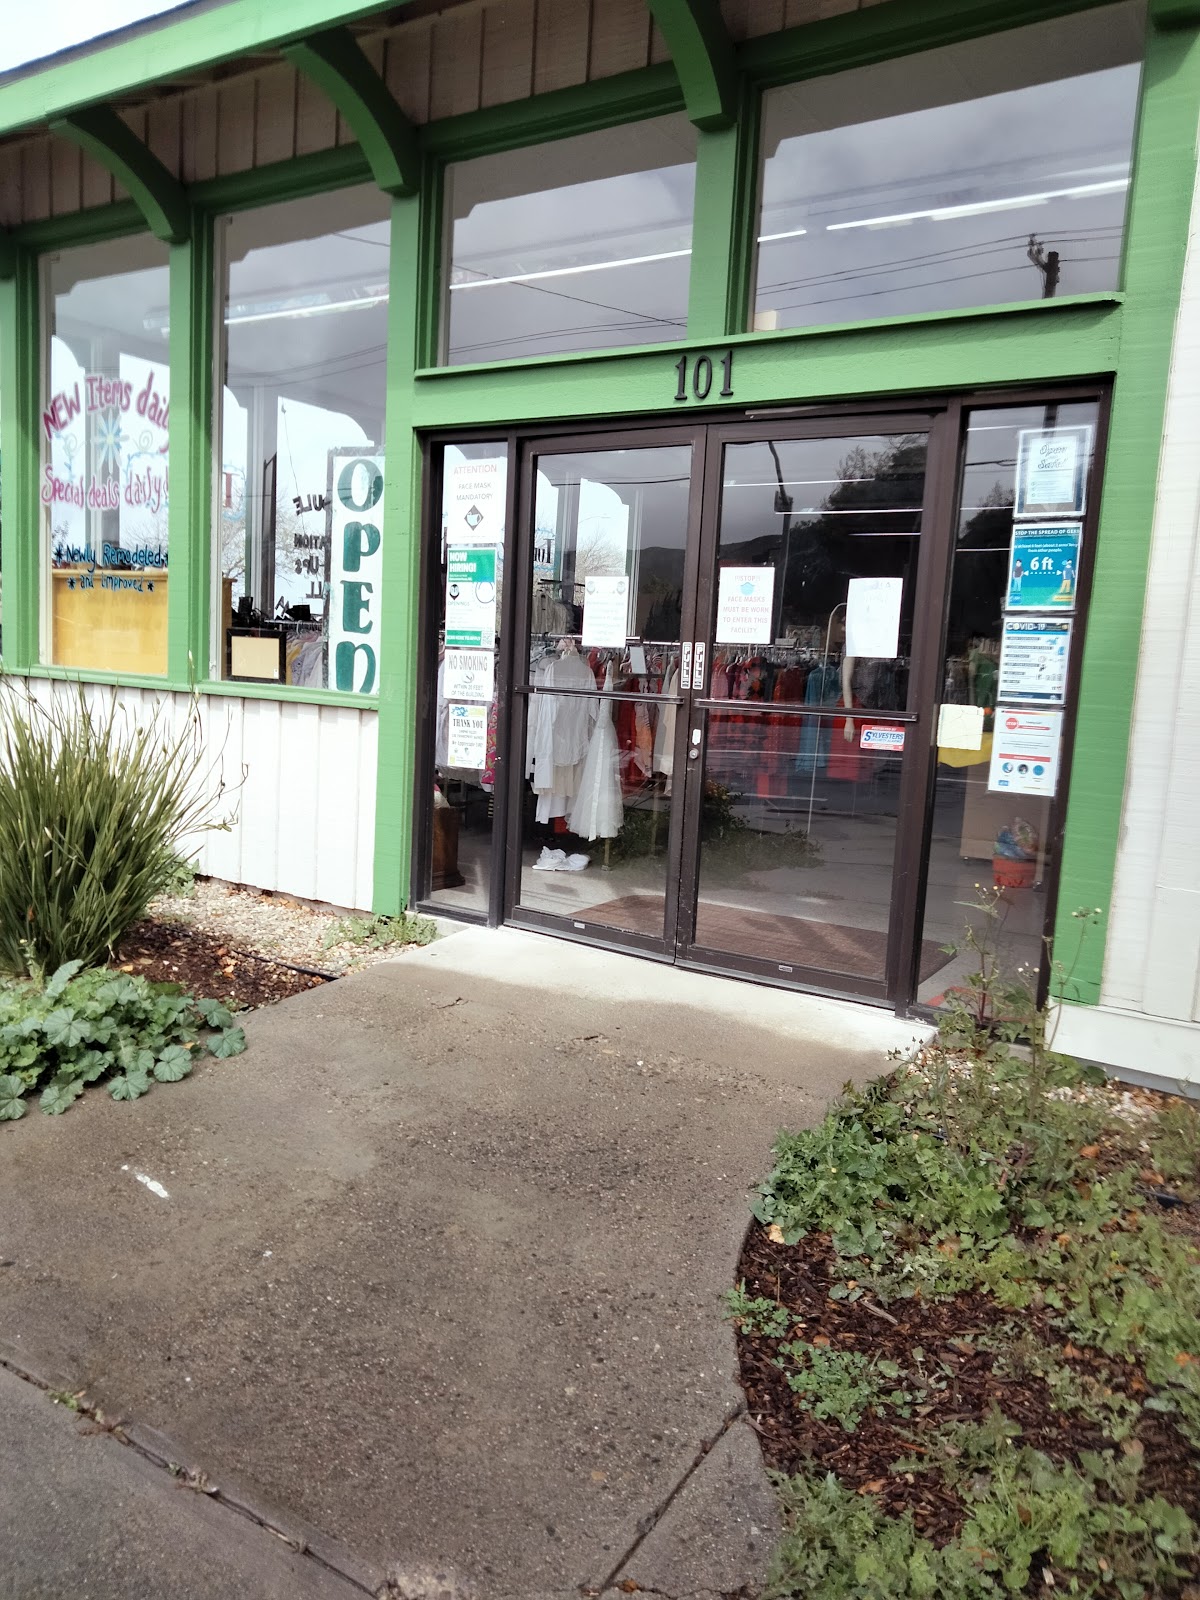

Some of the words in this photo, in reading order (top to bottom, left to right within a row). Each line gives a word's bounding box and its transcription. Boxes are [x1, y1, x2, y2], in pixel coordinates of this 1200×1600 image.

[674, 350, 734, 400] 101
[43, 382, 81, 440] NEW
[85, 375, 132, 412] Items
[454, 464, 497, 475] ATTENTION
[41, 464, 85, 508] Special
[88, 474, 119, 508] deals
[456, 492, 493, 501] MANDATORY
[66, 543, 96, 573] Newly
[102, 543, 161, 566] Remodeled
[449, 551, 468, 562] NOW
[1030, 556, 1040, 571] 6
[1041, 555, 1054, 571] ft
[449, 562, 477, 573] HIRING!
[80, 574, 94, 588] and
[1006, 622, 1046, 631] COVID-19
[448, 654, 458, 670] NO
[459, 655, 488, 672] SMOKING
[683, 645, 691, 678] PULL
[695, 645, 704, 678] PULL
[453, 718, 471, 728] THANK
[472, 719, 483, 729] YOU
[864, 731, 904, 742] SYLVESTERS
